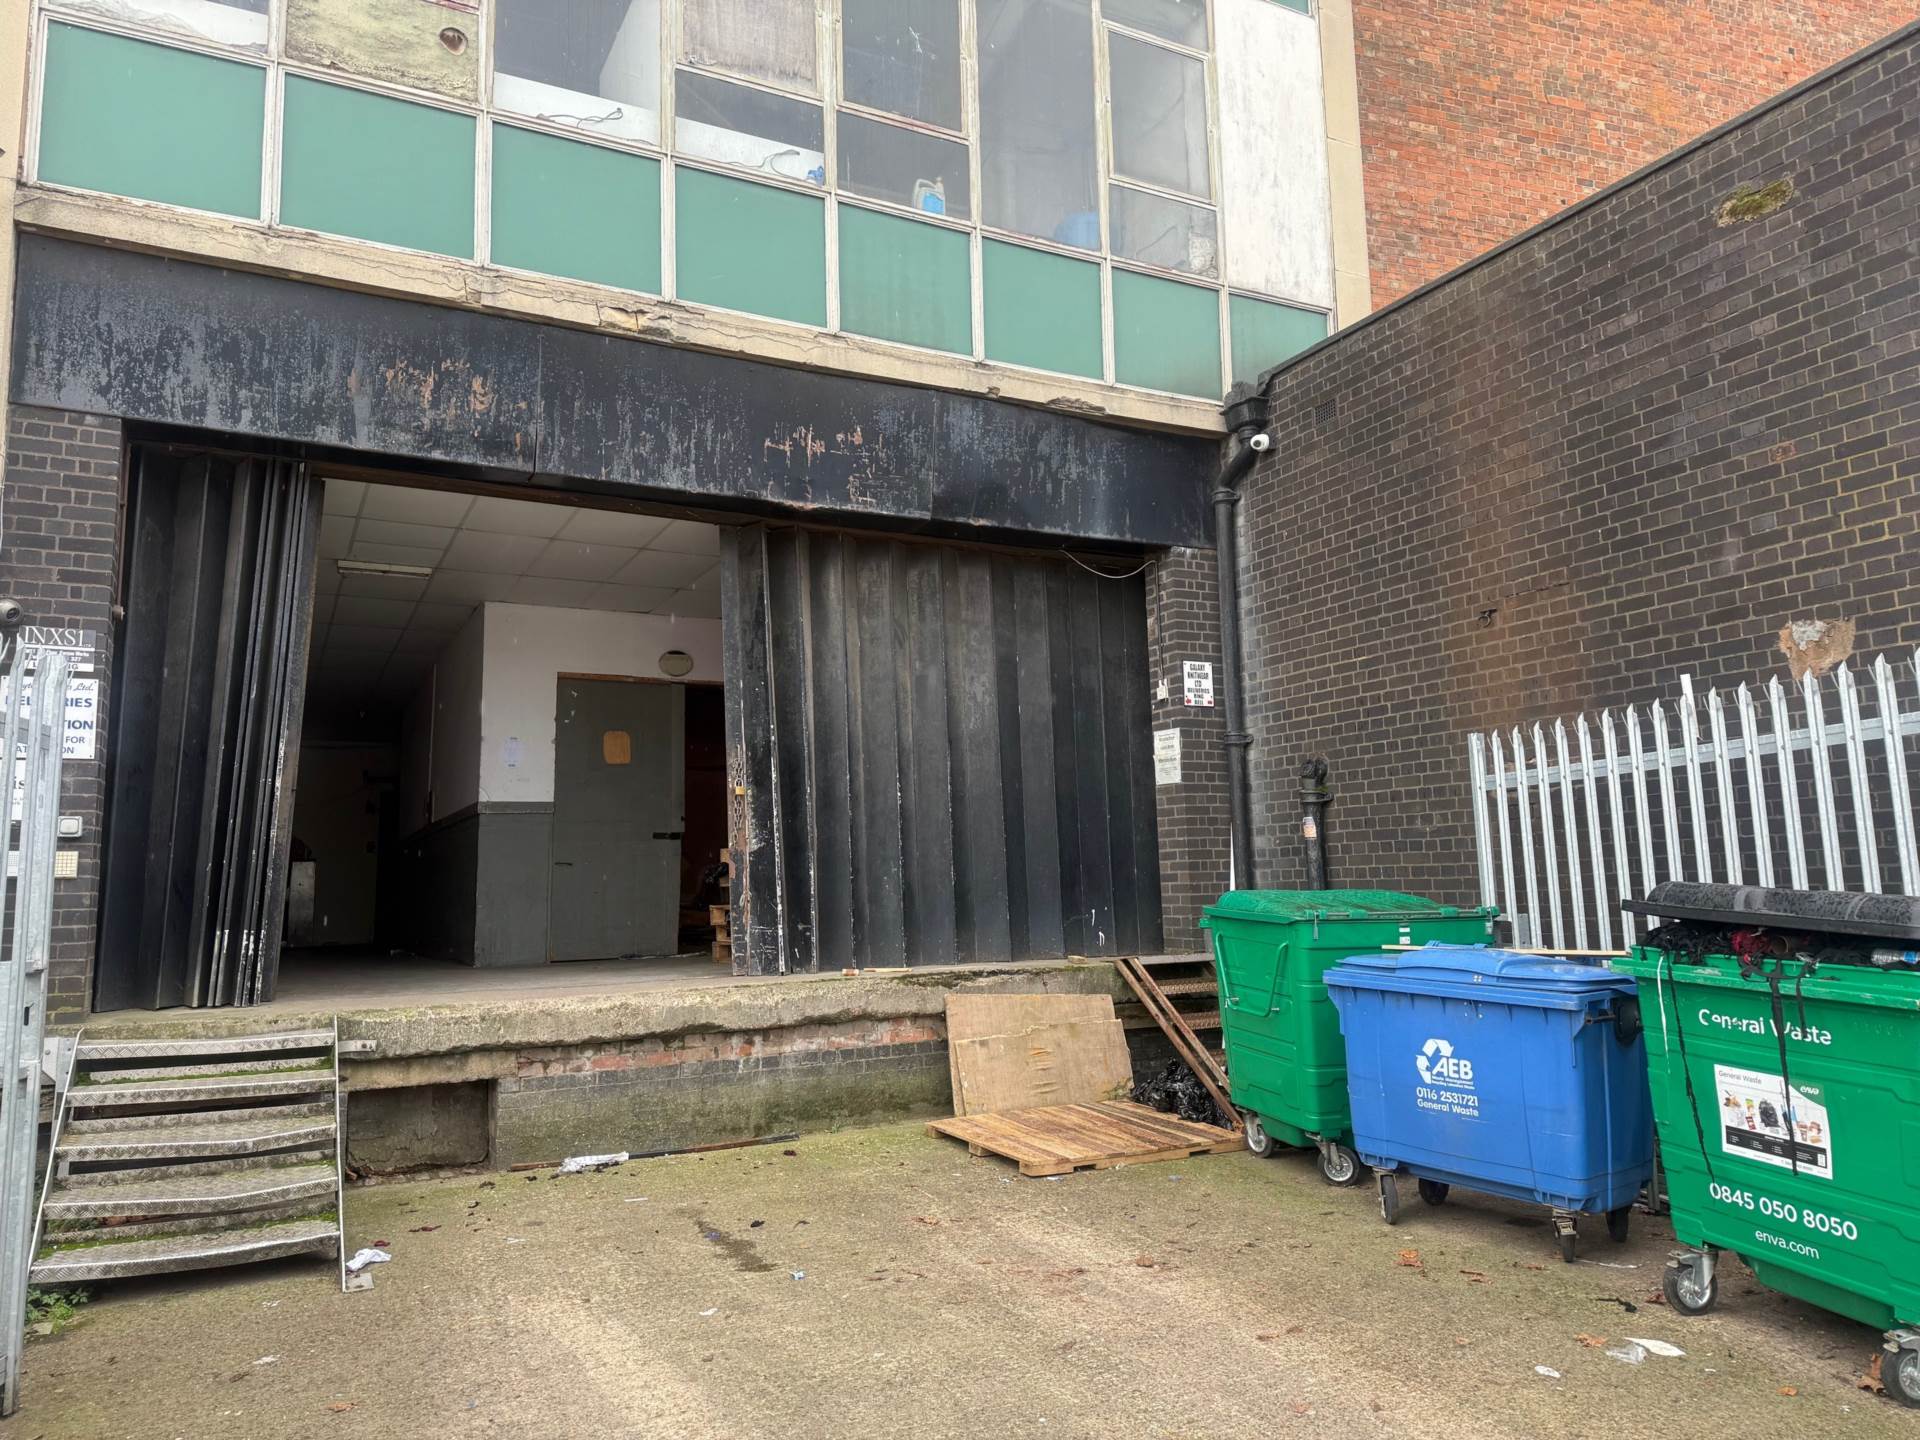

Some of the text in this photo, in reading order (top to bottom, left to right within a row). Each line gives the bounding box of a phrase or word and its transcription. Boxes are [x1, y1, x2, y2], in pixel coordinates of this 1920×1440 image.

[65, 735, 86, 744] FOR
[1432, 1056, 1473, 1080] AEB
[1719, 1070, 1762, 1085] General Waste
[1416, 1086, 1438, 1100] 0116
[1440, 1091, 1479, 1107] 2531721
[1800, 1085, 1820, 1096] enva
[1417, 1098, 1479, 1117] General Waste
[1709, 1182, 1858, 1241] 0845 050 8050
[1755, 1230, 1820, 1260] enva.com
